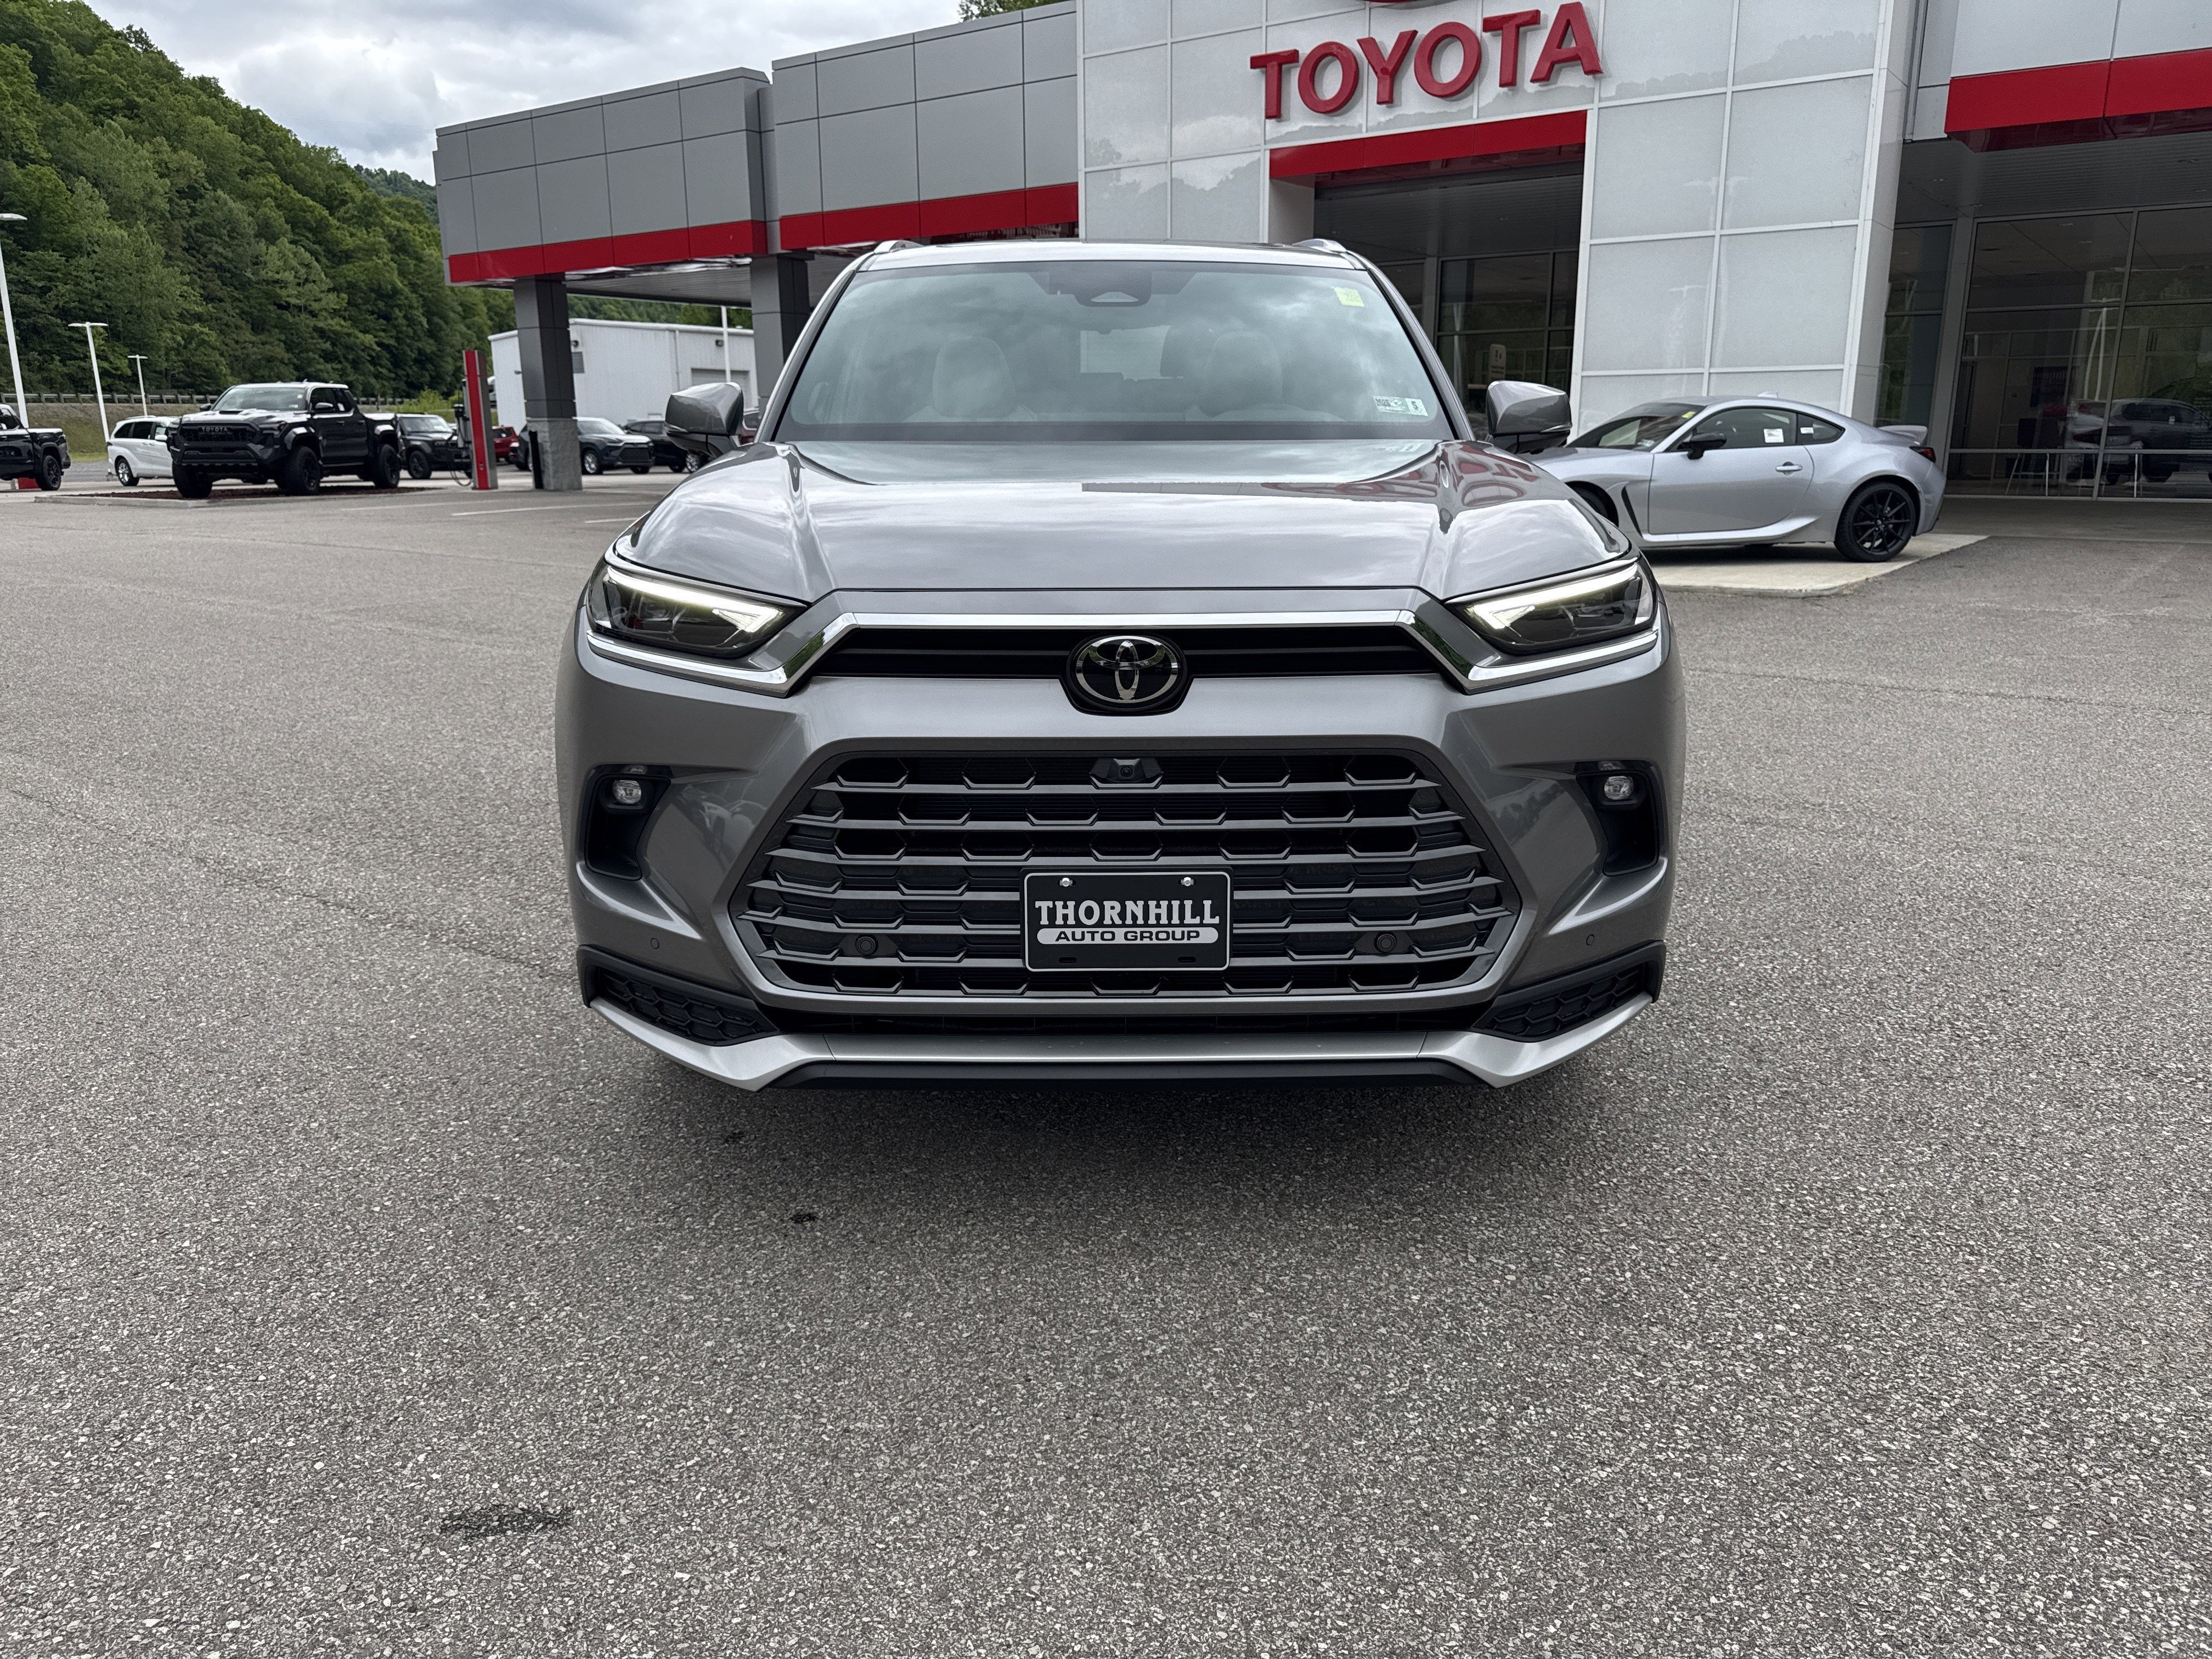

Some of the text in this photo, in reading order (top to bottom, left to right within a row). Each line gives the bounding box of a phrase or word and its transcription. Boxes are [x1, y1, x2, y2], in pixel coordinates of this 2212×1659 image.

[1250, 2, 1603, 120] TOYOTA
[1035, 900, 1220, 926] THORNHILL
[1055, 930, 1200, 942] AUTO GROUP
